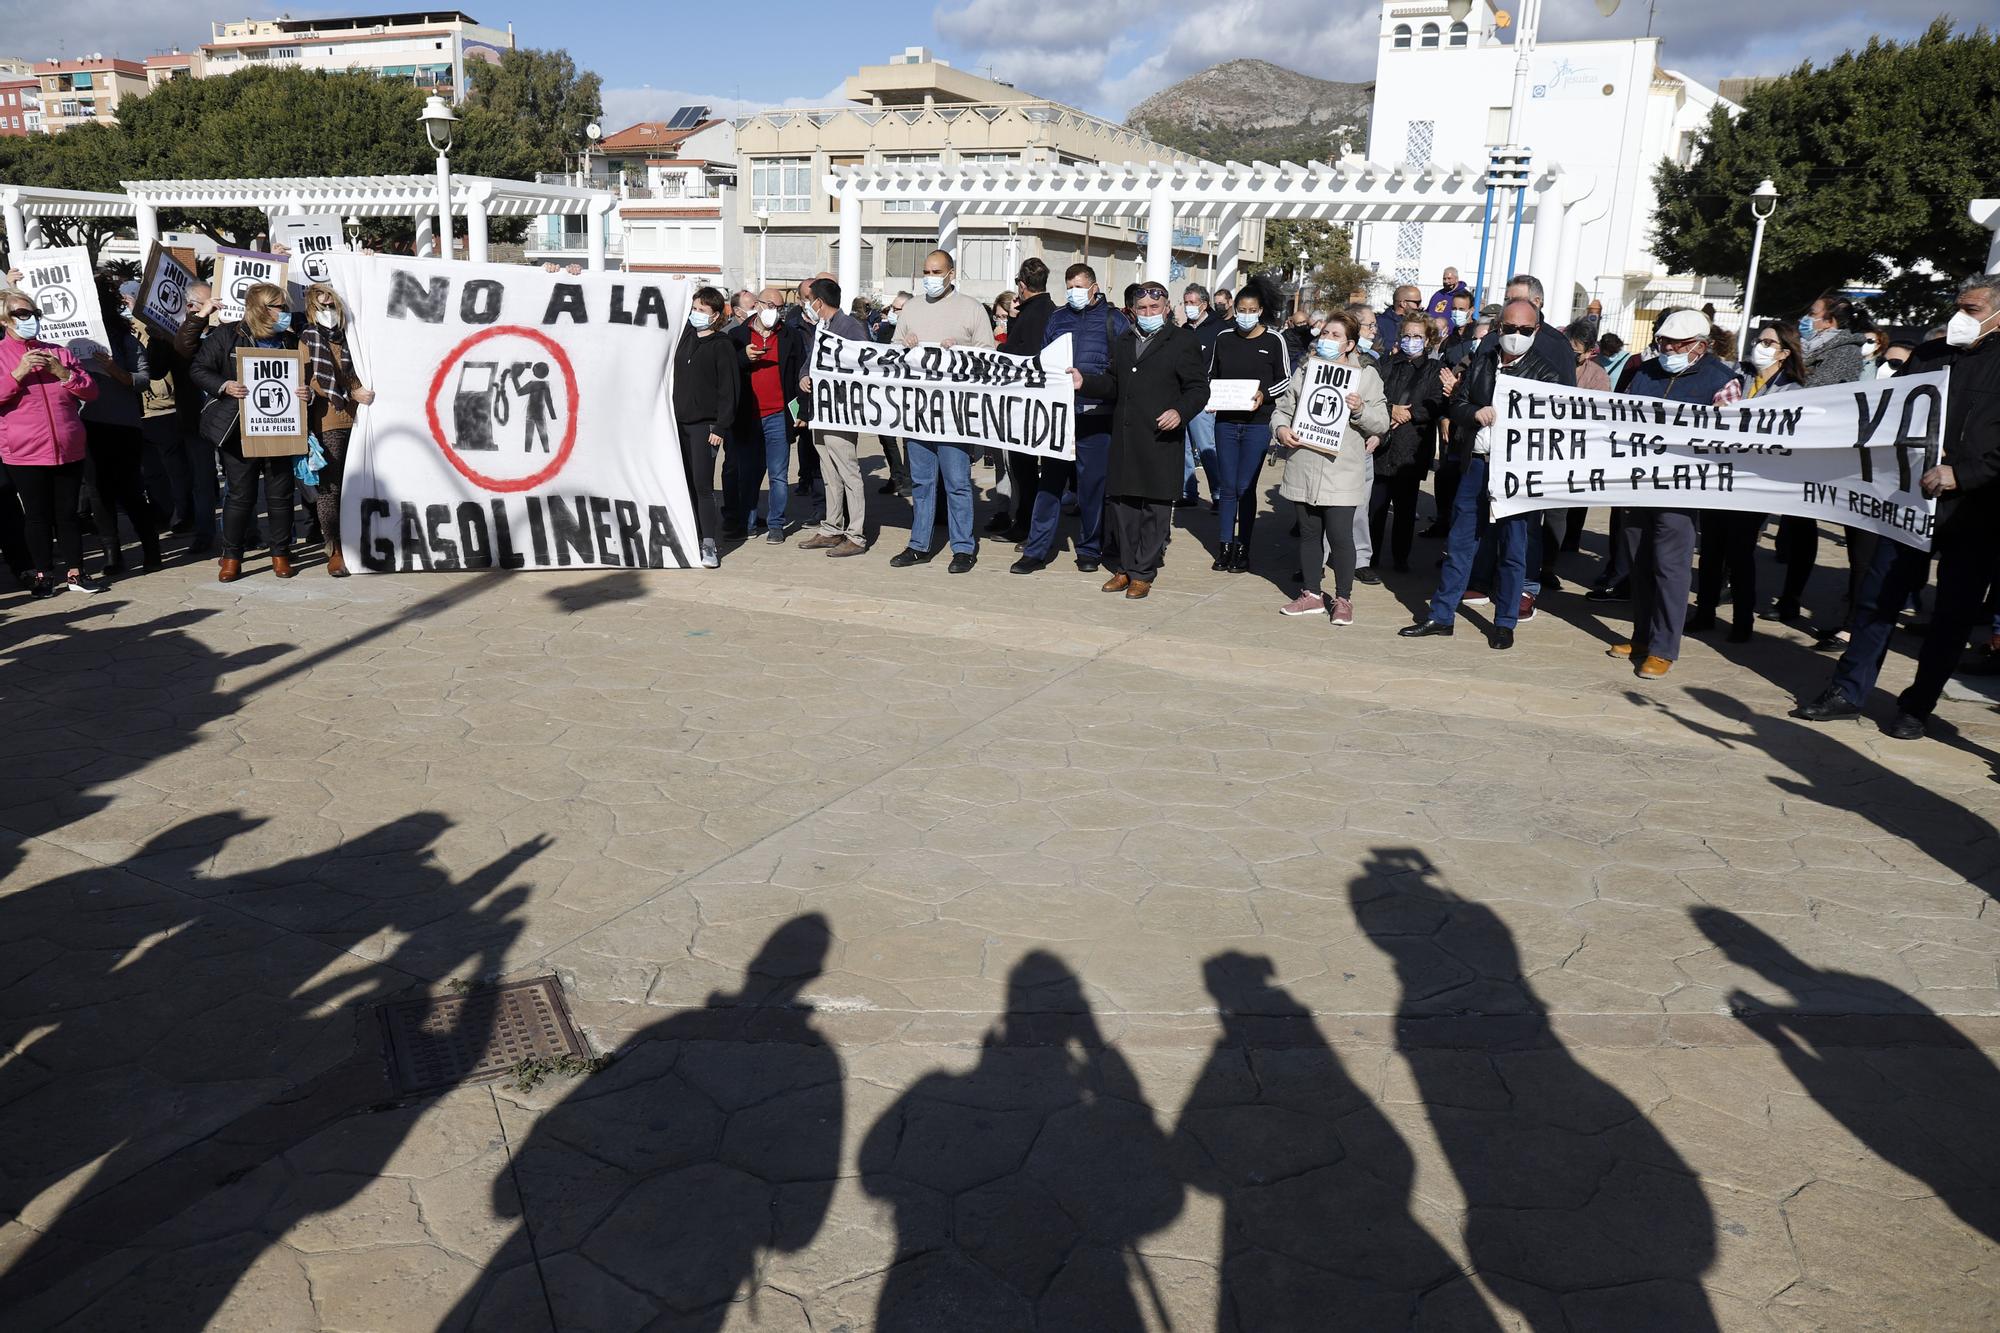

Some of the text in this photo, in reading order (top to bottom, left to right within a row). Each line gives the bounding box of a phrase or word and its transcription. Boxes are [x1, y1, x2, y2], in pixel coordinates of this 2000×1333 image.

[299, 236, 333, 254] ¡NO!
[29, 265, 71, 288] ¡NO!
[164, 262, 188, 290] ¡NO!
[234, 260, 271, 279] ¡NO!
[386, 267, 669, 330] NO A LA
[49, 320, 87, 330] GASOLINERA
[50, 331, 59, 339] LA
[62, 329, 89, 337] PELUSA
[253, 360, 288, 380] ¡NO!
[817, 330, 1047, 388] EL PALO UNIDO
[1314, 364, 1352, 389] ¡NO!
[1310, 425, 1340, 438] GASOLINERA
[1316, 435, 1339, 447] PELUSA
[1853, 384, 1942, 500] YA
[1506, 428, 1586, 462] PARA
[1609, 430, 1667, 458] LAS
[1504, 461, 1734, 499] DE LA PLAYA
[1848, 490, 1936, 538] REBALAJE
[360, 494, 692, 571] GASOLINERA
